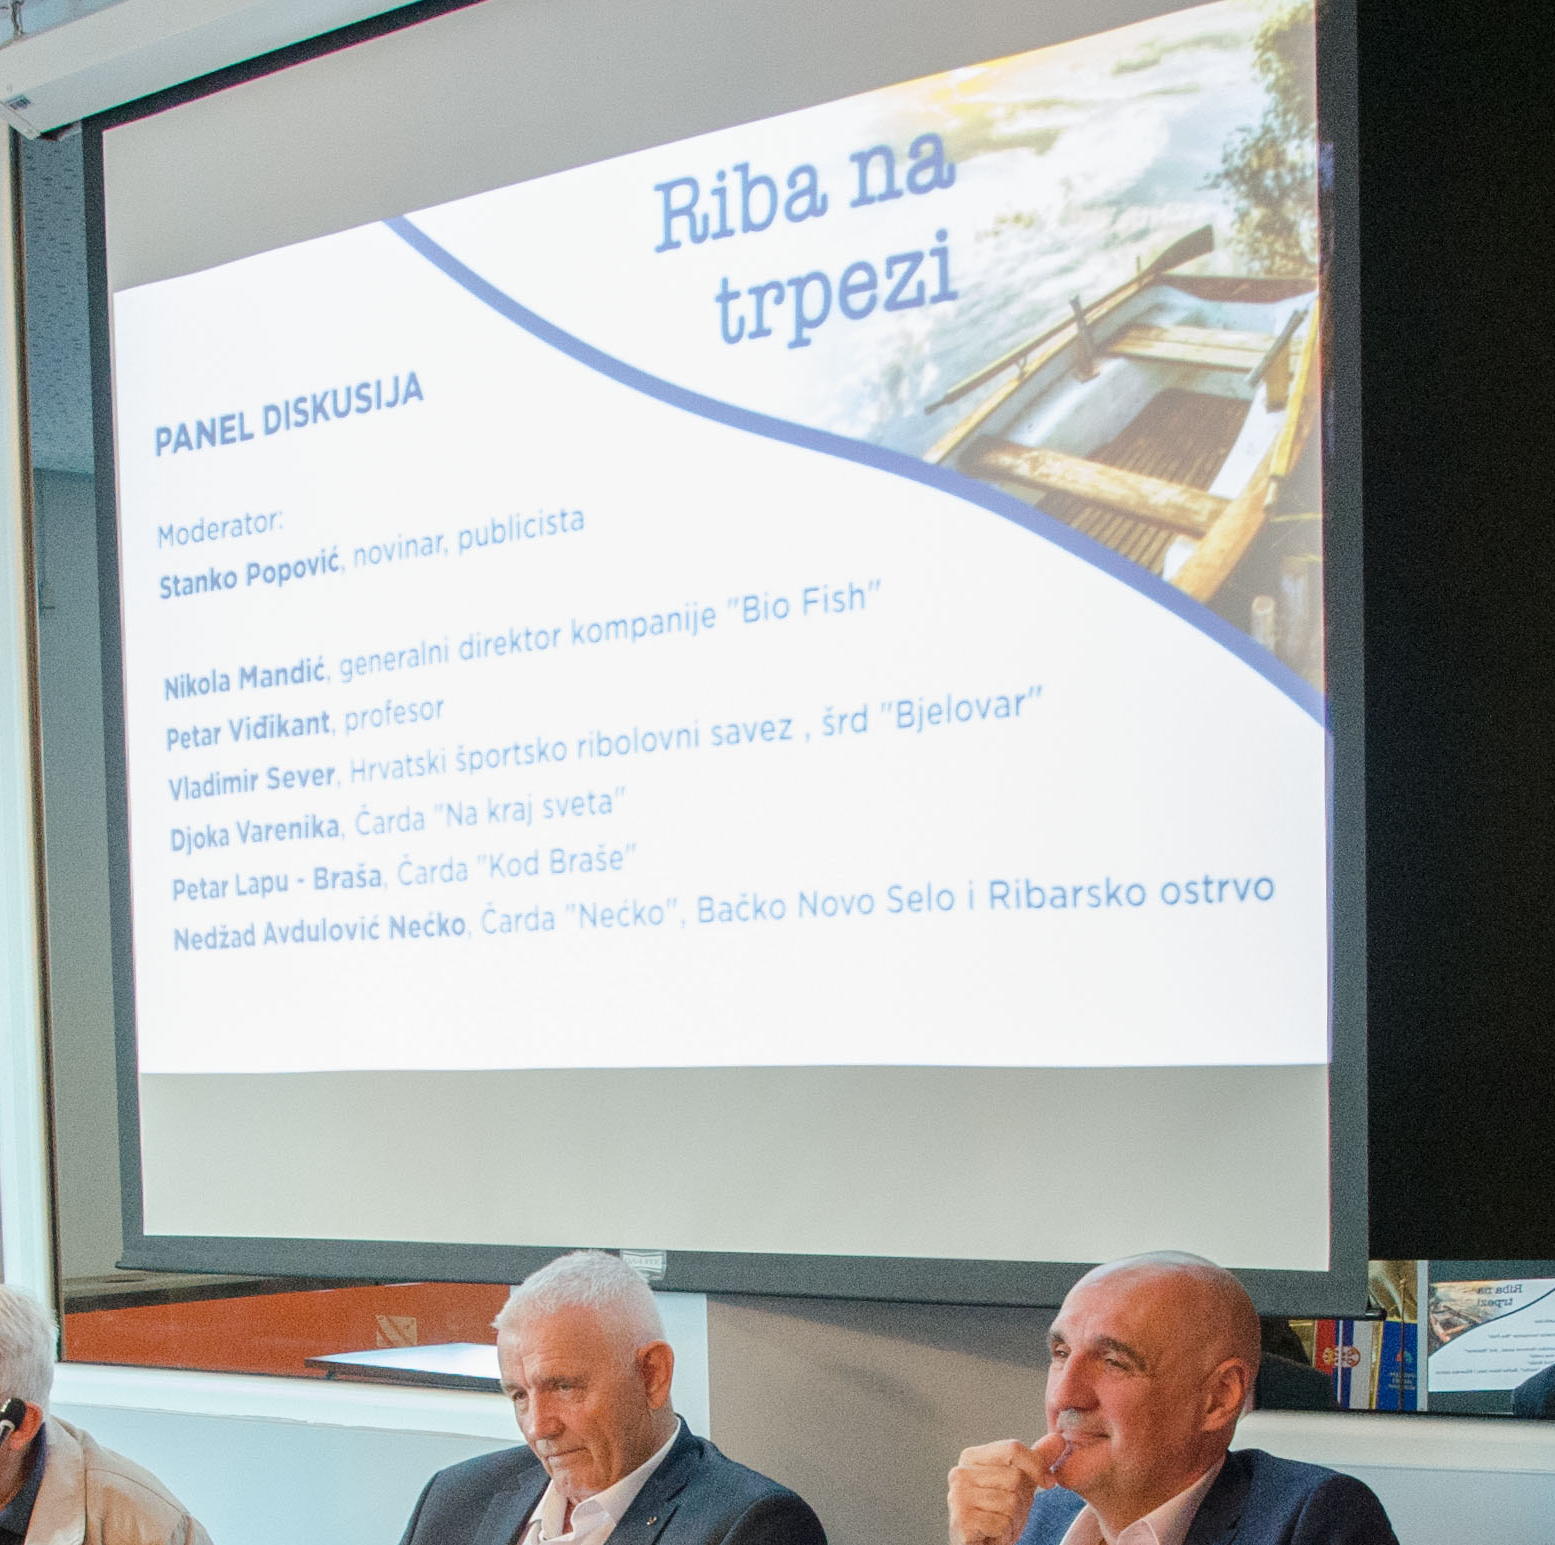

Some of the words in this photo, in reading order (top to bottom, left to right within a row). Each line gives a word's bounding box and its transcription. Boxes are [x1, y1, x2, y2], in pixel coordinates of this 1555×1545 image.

[653, 161, 829, 254] Riba
[849, 132, 957, 209] na
[714, 228, 959, 350] trpezi
[155, 411, 255, 457] PANEL
[263, 370, 425, 436] DISKUSIJA
[157, 510, 284, 549] Moderator:
[160, 566, 238, 600] Stanko
[246, 546, 346, 587] Popović,
[353, 531, 449, 569] novinar,
[458, 508, 586, 556] publicista
[165, 669, 231, 701] Nikola
[239, 655, 332, 690] Mandić,
[340, 637, 450, 684] generalni
[459, 624, 561, 662] direktor
[571, 602, 717, 646] kompanije
[727, 591, 790, 624] "Bio
[802, 578, 882, 616] Fish"
[166, 725, 221, 752] Petar
[344, 698, 445, 736] profesor
[168, 768, 259, 801] Vladimir
[267, 765, 341, 791] Sever,
[350, 750, 447, 784] Hrvatski
[455, 737, 567, 776] športsko
[577, 720, 700, 760] ribolovni
[711, 716, 793, 747] savez
[822, 706, 869, 737] šrd
[881, 686, 1043, 733] "Bjelovar"
[171, 826, 230, 856] Djoka
[237, 814, 346, 844] Varenika,
[355, 805, 425, 836] Čarda
[433, 802, 478, 828] "Na
[487, 794, 533, 827] kraj
[543, 786, 626, 819] sveta"
[173, 877, 228, 902] Petar
[236, 871, 289, 900] Lapu
[314, 865, 388, 891] Braša,
[397, 853, 468, 886] Čarda
[477, 849, 539, 879] "Kod
[550, 843, 637, 875] Braše"
[174, 922, 256, 952] Nedžad
[263, 913, 380, 946] Avdulović
[388, 912, 472, 941] Nećko,
[481, 902, 556, 935] Čarda
[565, 898, 686, 929] "Nećko",
[697, 892, 787, 925] Bačko
[798, 891, 876, 919] Novo
[886, 883, 955, 914] Selo
[968, 880, 974, 911] i
[989, 877, 1147, 911] Ribarsko
[1160, 873, 1276, 906] ostrvo
